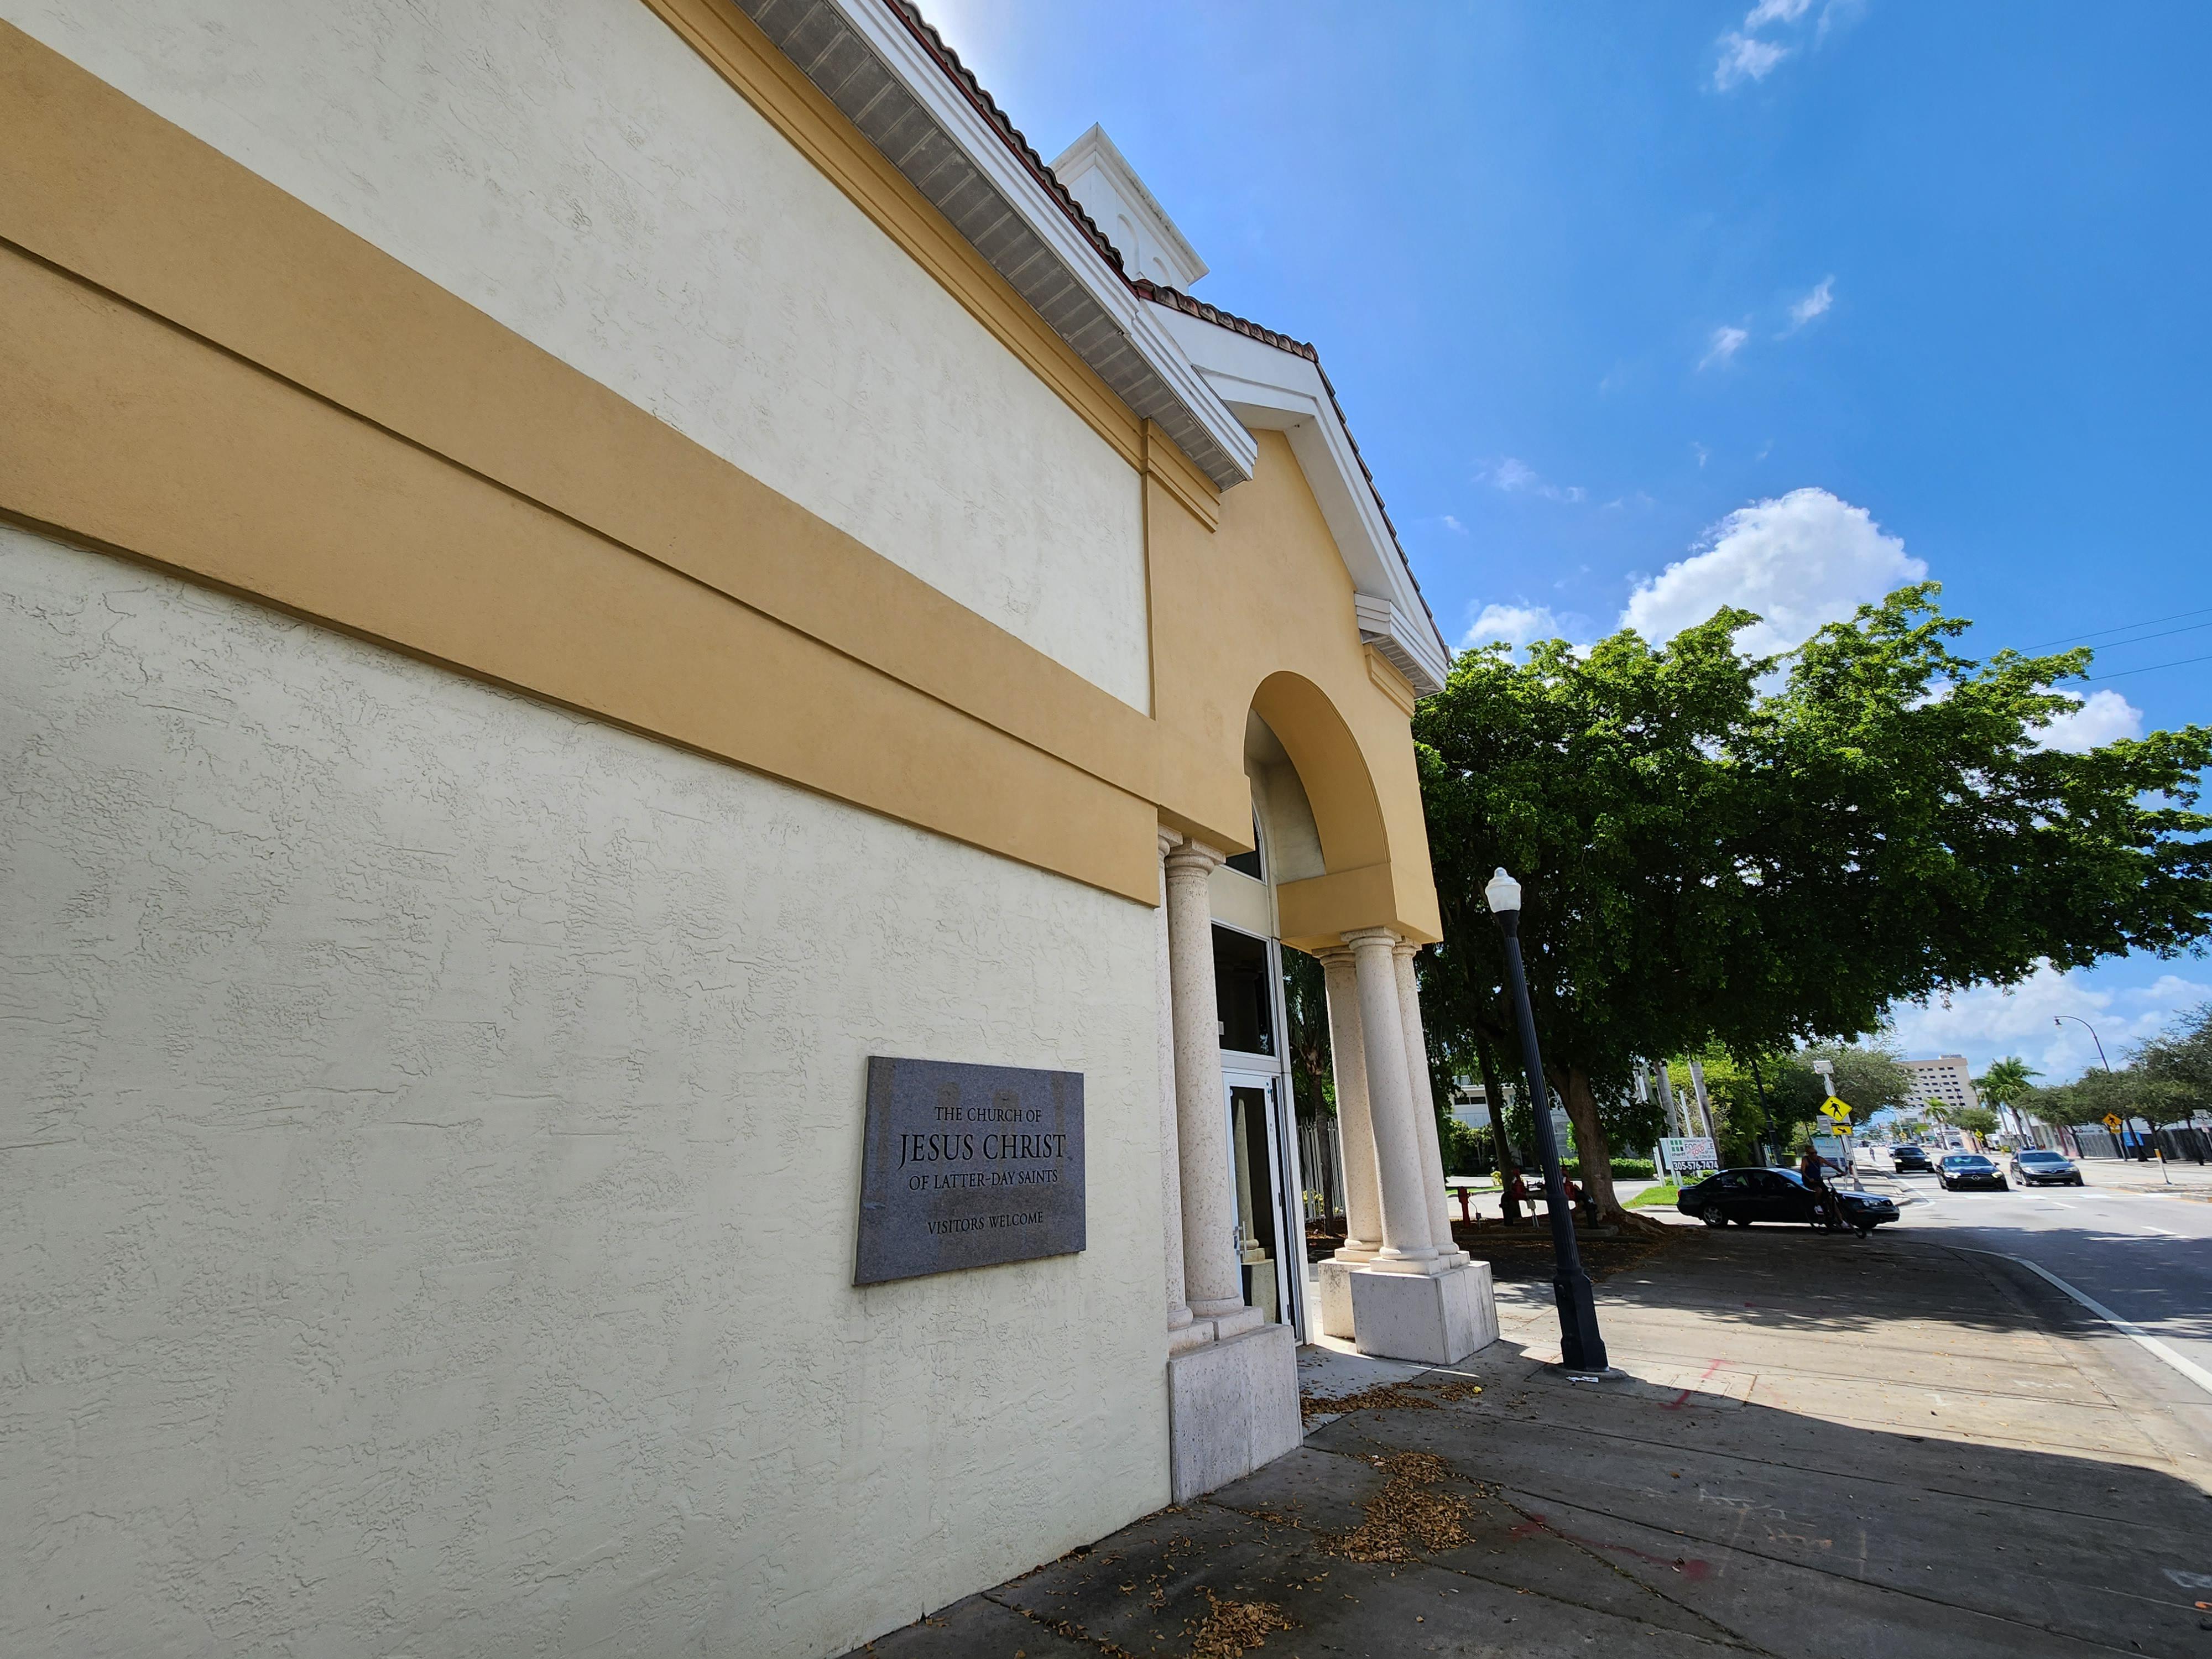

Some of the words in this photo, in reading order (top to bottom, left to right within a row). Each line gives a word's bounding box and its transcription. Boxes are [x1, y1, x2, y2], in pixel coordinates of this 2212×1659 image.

[935, 1107, 962, 1121] THE
[967, 1108, 1023, 1122] CHURCH
[1026, 1109, 1042, 1123] OF
[898, 1134, 974, 1170] JESUS
[983, 1134, 1066, 1160] CHRIST
[1692, 1146, 1704, 1156] SOLD
[1673, 1161, 1719, 1170] 305-576-7474
[909, 1176, 929, 1190] OF
[934, 1171, 1015, 1189] LATTER-DAY
[1018, 1169, 1058, 1184] SAINTS
[928, 1217, 984, 1234] VISITORS
[989, 1212, 1043, 1228] WELCOME
